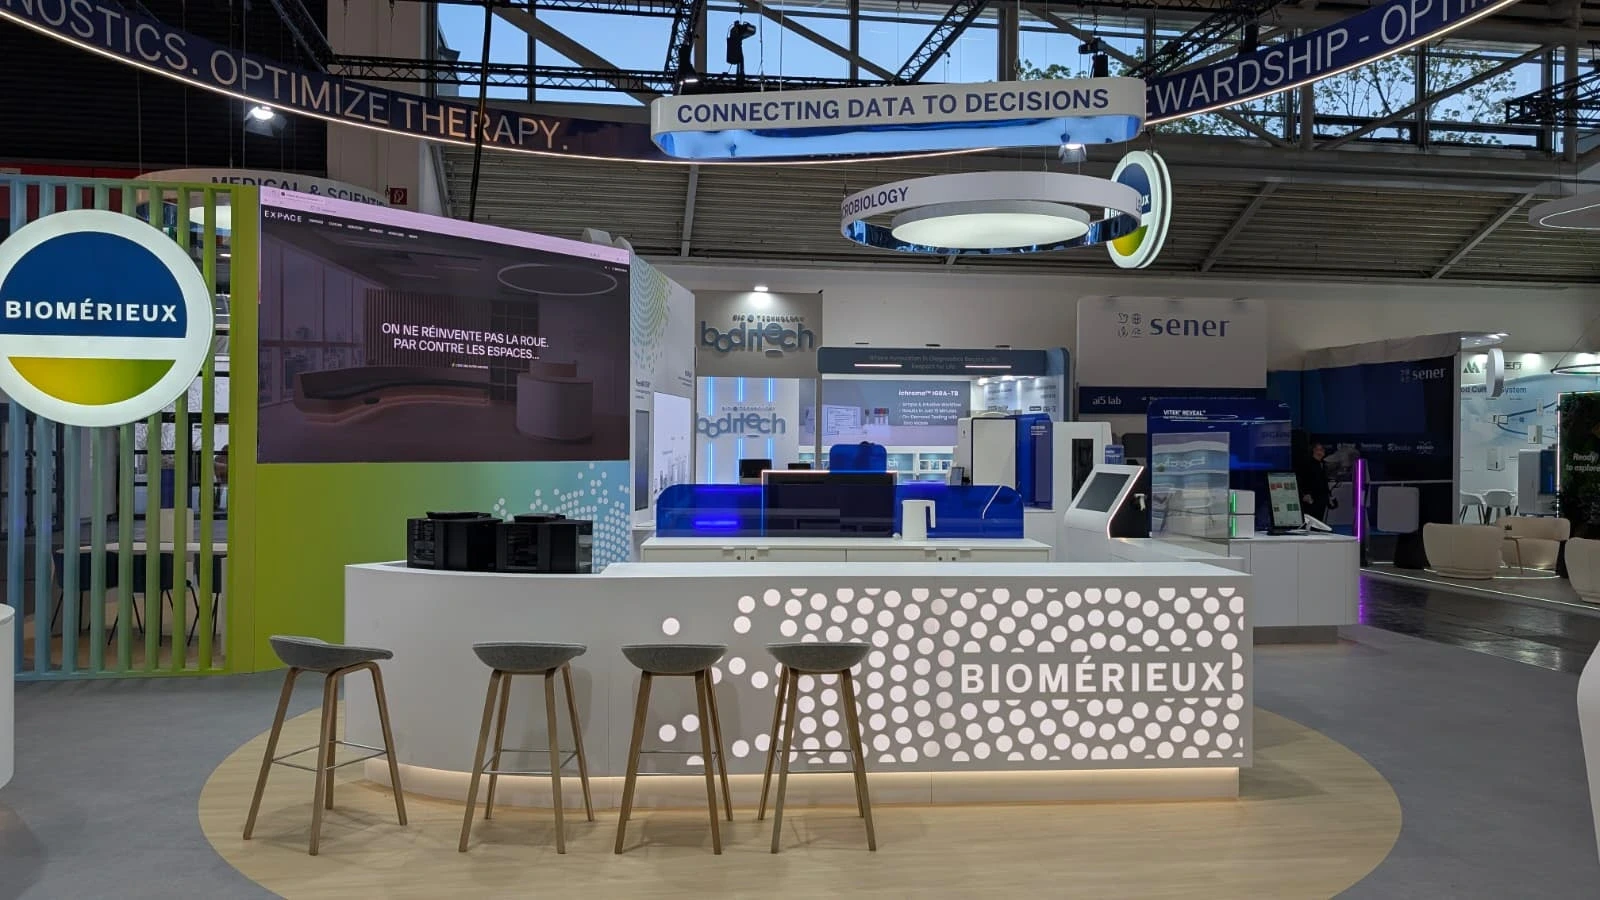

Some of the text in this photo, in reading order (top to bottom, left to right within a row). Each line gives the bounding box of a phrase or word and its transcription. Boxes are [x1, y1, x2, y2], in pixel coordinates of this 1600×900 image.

[210, 50, 389, 125] OPTIMIZE
[398, 98, 568, 150] THERAPY.
[677, 88, 1109, 123] CONNECTING DATA TO DECISIONS
[310, 184, 321, 196] &
[264, 210, 302, 223] EXPACE
[5, 298, 177, 322] BIOMÉRIEUX
[381, 322, 549, 348] ON NE RÉINVENTE PAS LA ROUE.
[1149, 318, 1230, 337] sener
[393, 338, 540, 360] PAR CONTRE LES ESPACES...
[1412, 368, 1446, 380] sener
[1108, 396, 1122, 405] lab
[961, 655, 1225, 694] BIOMÉRIEUX
